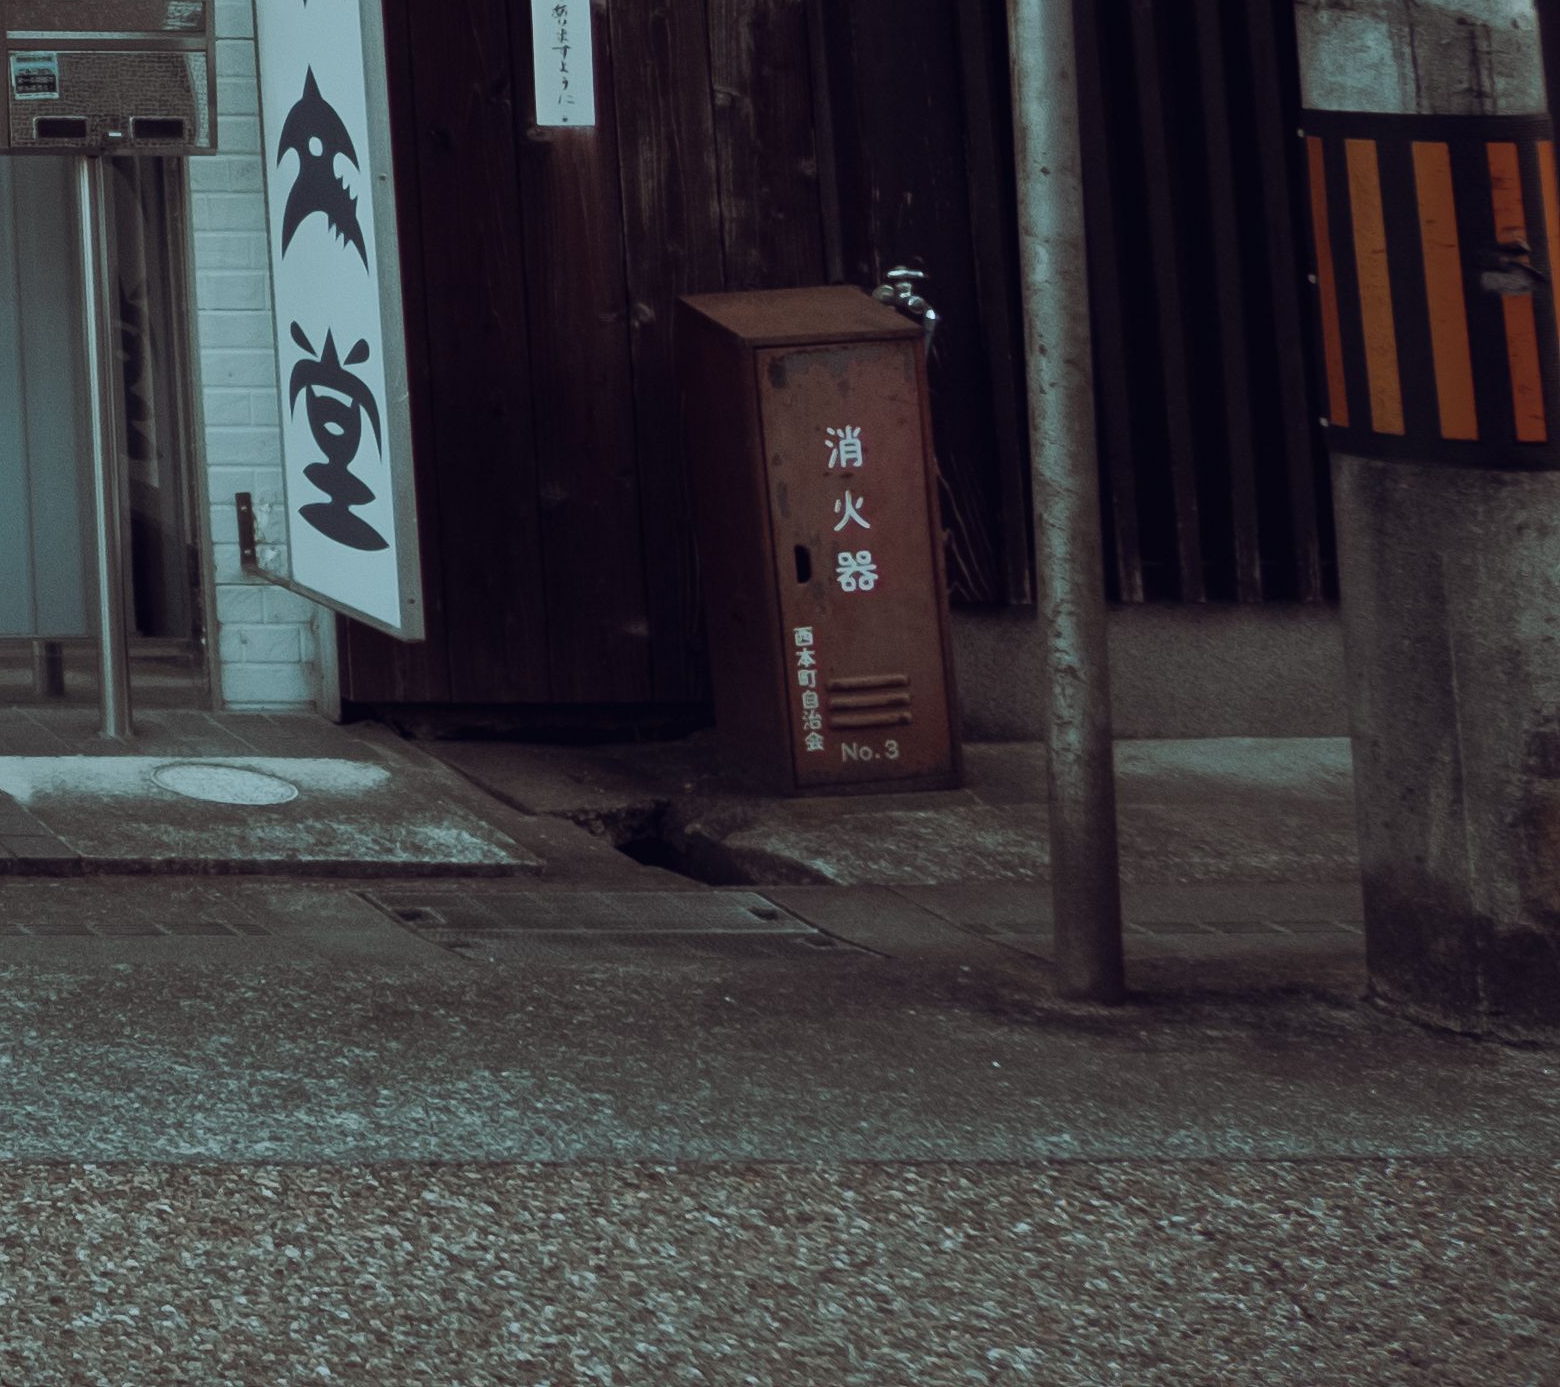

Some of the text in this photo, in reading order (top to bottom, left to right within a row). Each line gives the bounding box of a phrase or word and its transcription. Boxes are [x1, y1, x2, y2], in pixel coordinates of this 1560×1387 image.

[823, 422, 879, 594] 消火器
[792, 625, 827, 754] 西本町自治会
[840, 737, 901, 764] No.3
